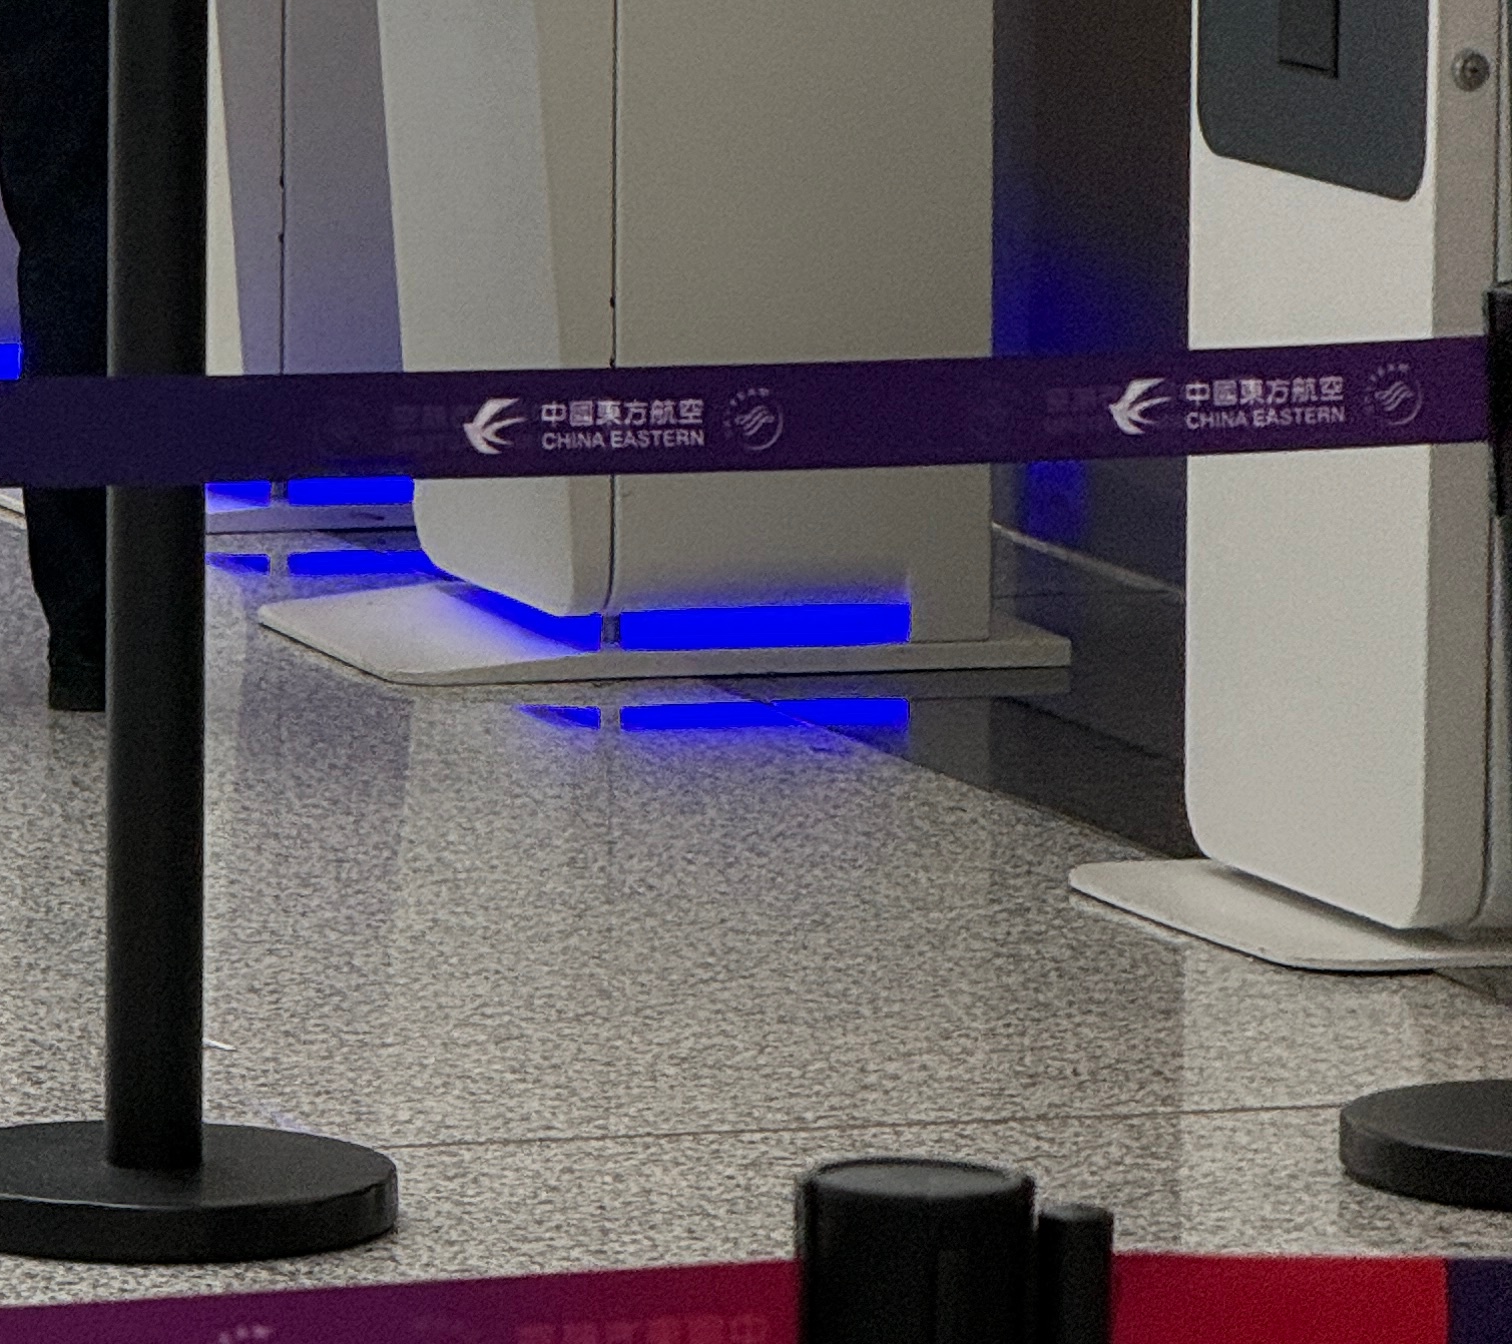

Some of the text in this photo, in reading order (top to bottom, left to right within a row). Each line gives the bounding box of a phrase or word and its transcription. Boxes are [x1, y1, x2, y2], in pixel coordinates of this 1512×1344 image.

[1184, 375, 1345, 407] 中國東方航空
[540, 397, 705, 427] 中國東方航空
[1185, 406, 1346, 430] CHINA EASTERN
[541, 428, 705, 451] CHINA EASTERN
